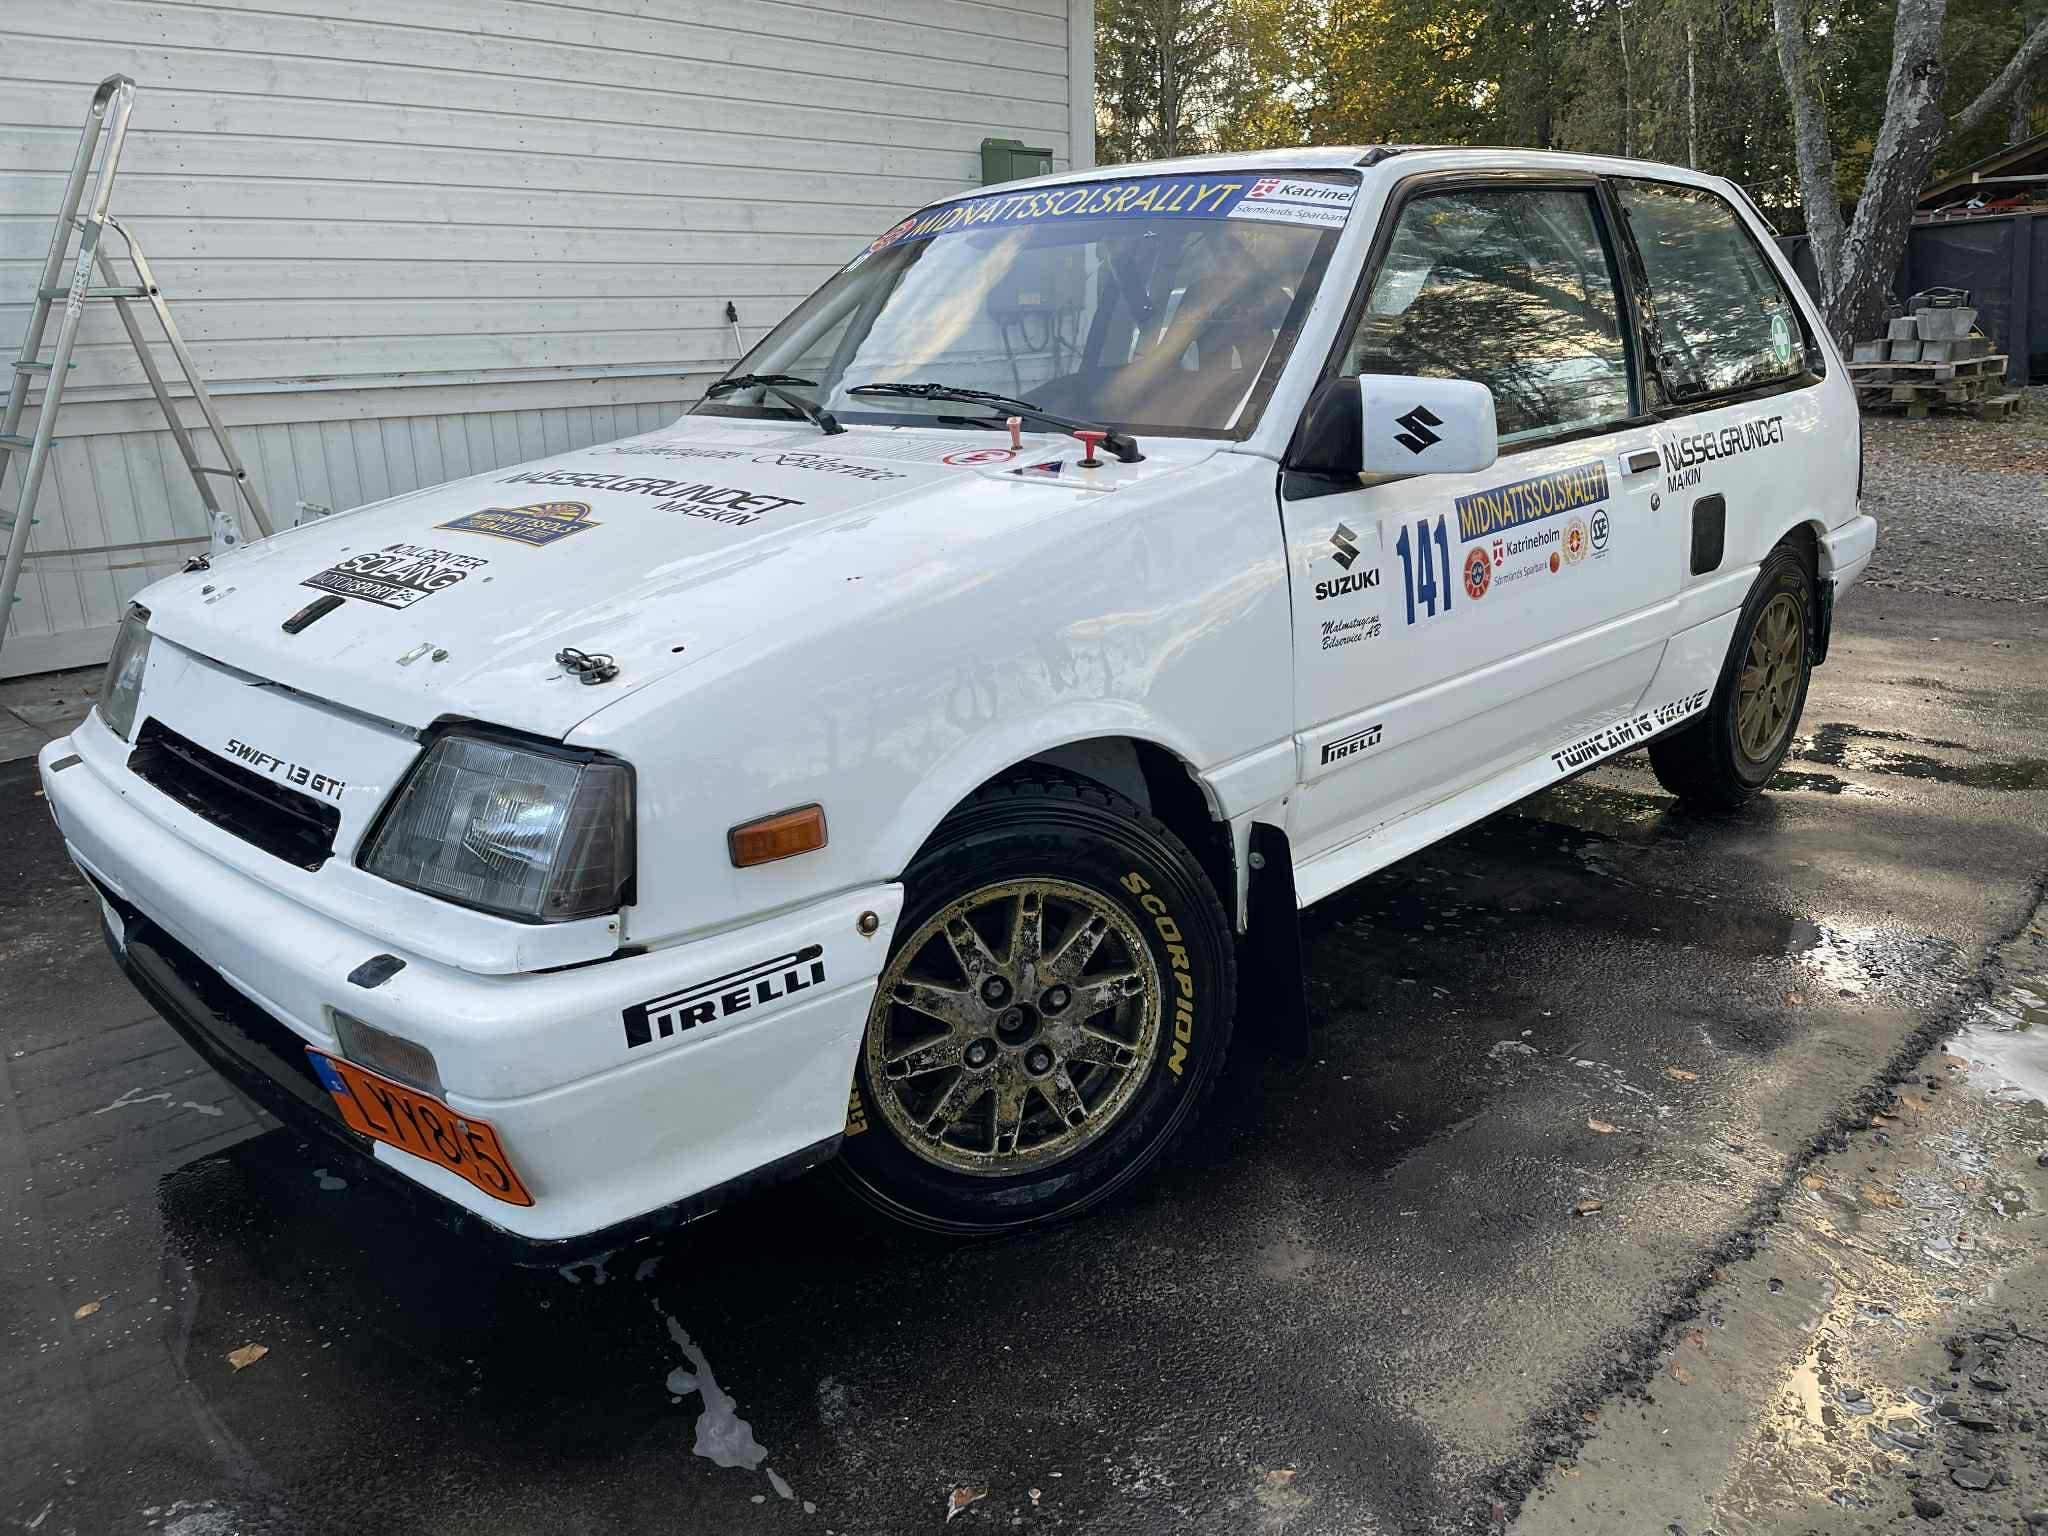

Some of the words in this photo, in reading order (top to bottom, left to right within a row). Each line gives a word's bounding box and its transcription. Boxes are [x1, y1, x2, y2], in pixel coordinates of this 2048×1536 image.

[652, 500, 760, 526] MASKIN
[1506, 528, 1560, 556] Katrineholm
[1315, 568, 1380, 600] SUZUKI
[1396, 513, 1452, 625] 141
[1364, 622, 1382, 640] AB
[1653, 688, 1709, 726] VALVE
[1320, 723, 1383, 766] PIRELLI
[224, 738, 286, 773] SWIFT
[311, 773, 346, 801] GTi
[1119, 872, 1194, 1076] SCORPION
[622, 943, 826, 1049] PIRELLI
